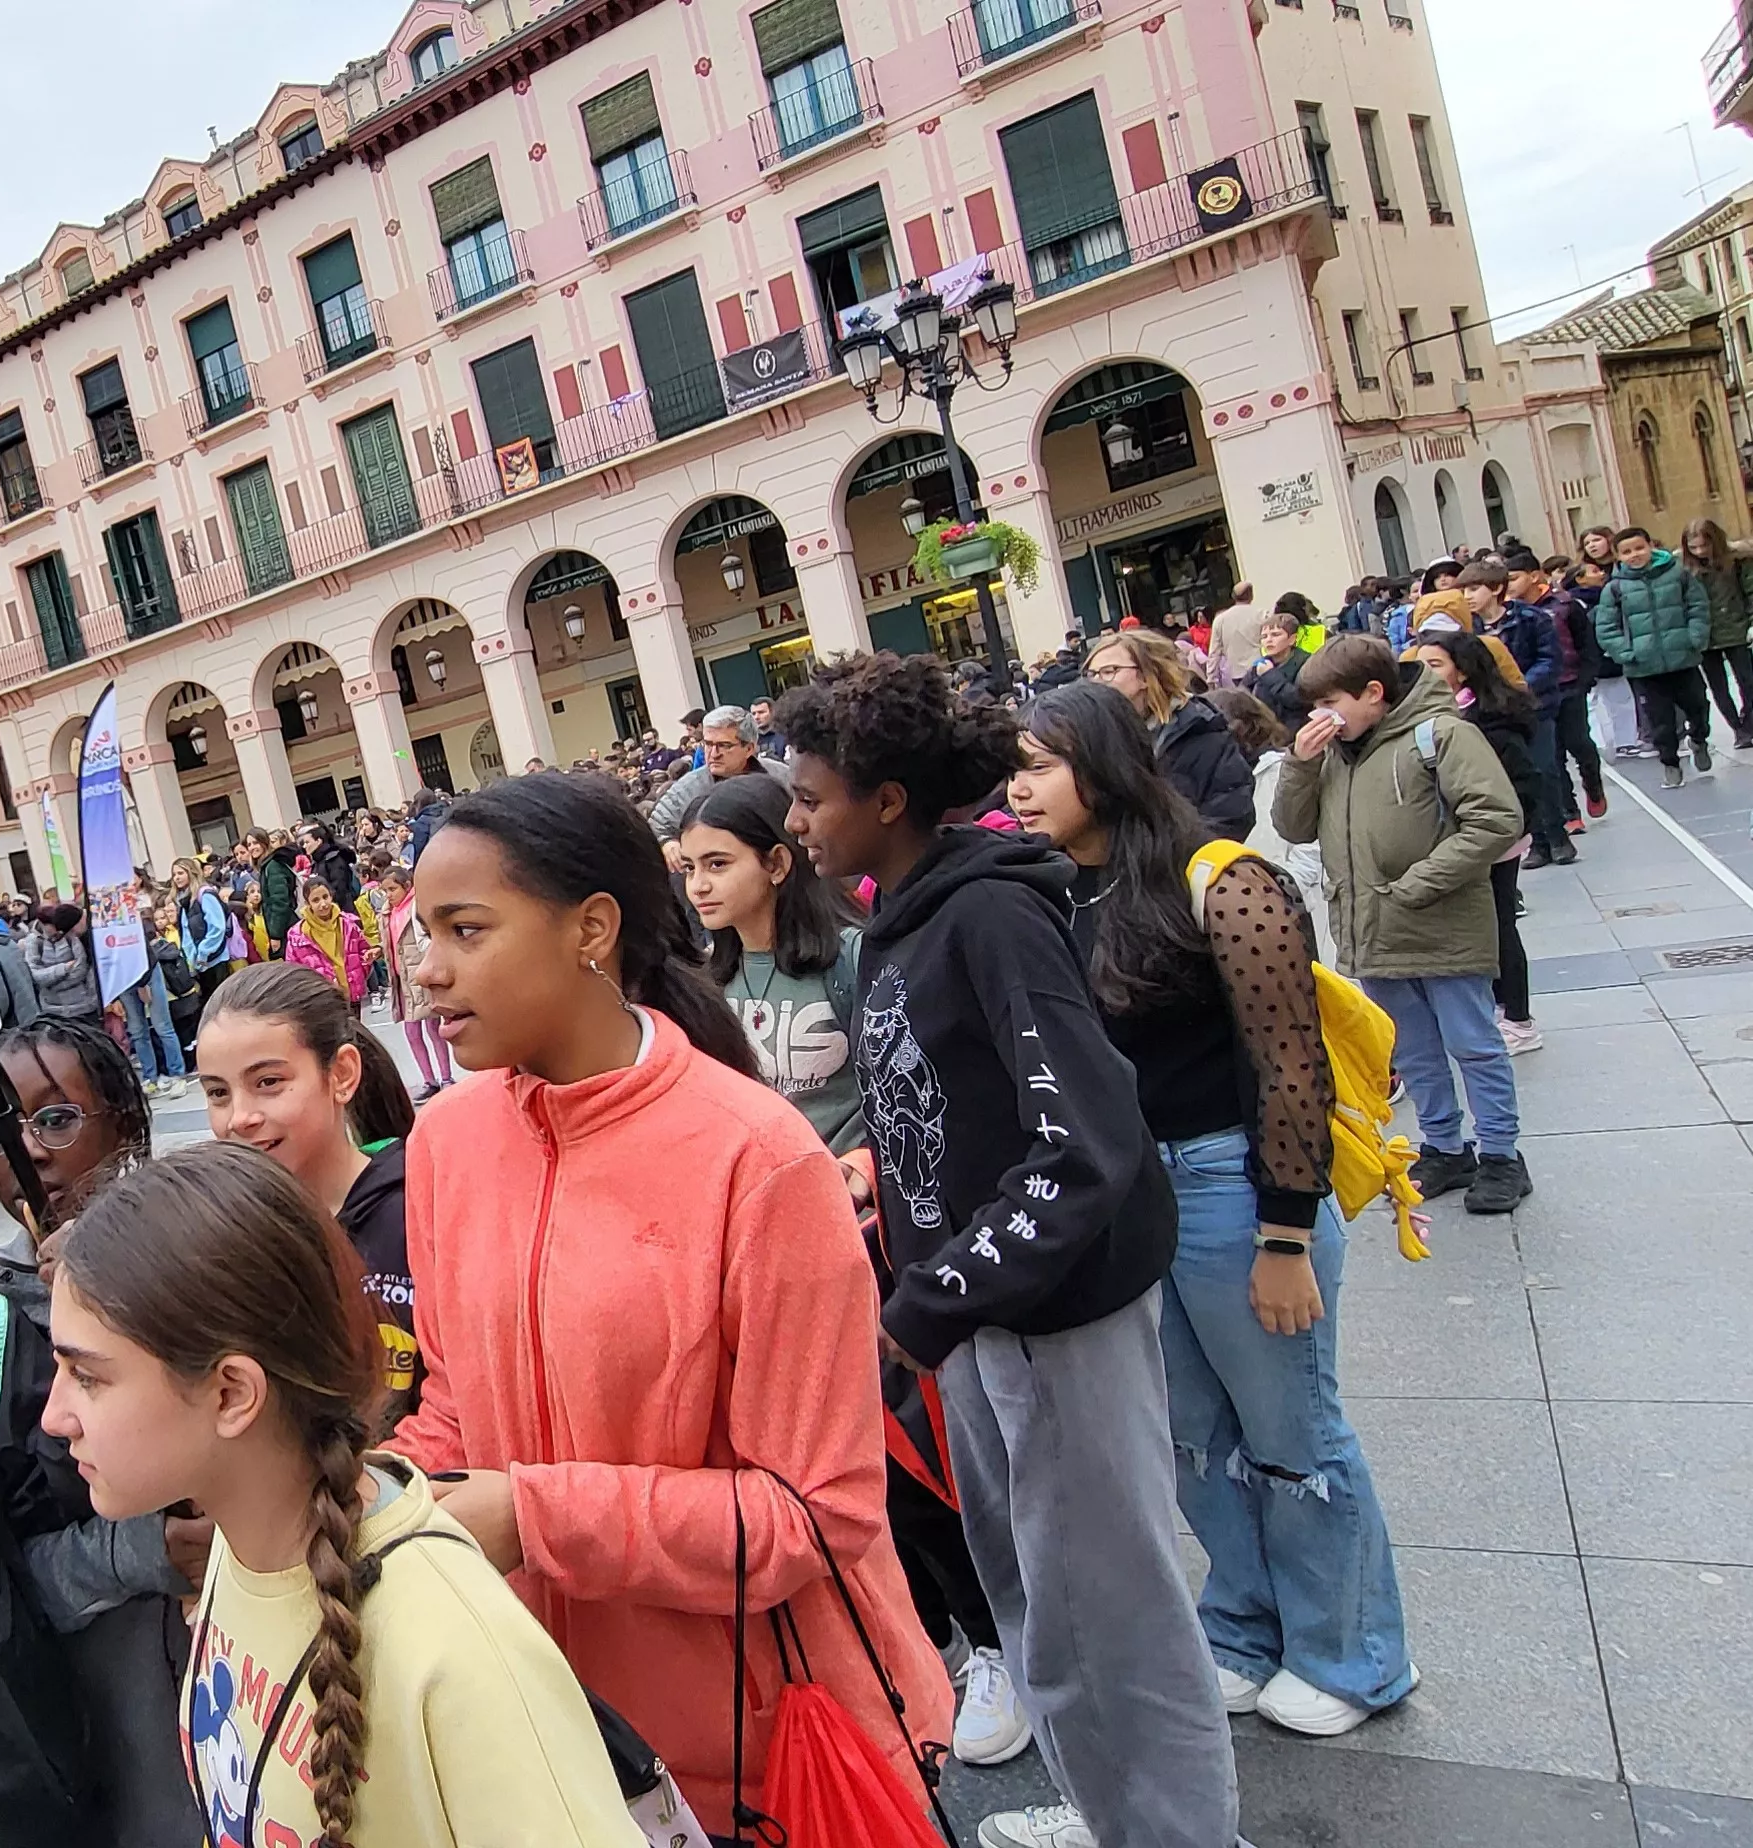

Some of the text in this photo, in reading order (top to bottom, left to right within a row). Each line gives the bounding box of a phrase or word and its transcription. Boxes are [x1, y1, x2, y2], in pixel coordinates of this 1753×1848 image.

[735, 369, 805, 400] SEMANA SANTA
[1121, 390, 1143, 406] 1871
[904, 463, 917, 480] LA
[915, 454, 950, 477] CONFIAN
[727, 524, 738, 539] LA
[737, 512, 777, 537] CONFIANZA
[755, 601, 796, 631] LA
[726, 998, 849, 1082] RIS
